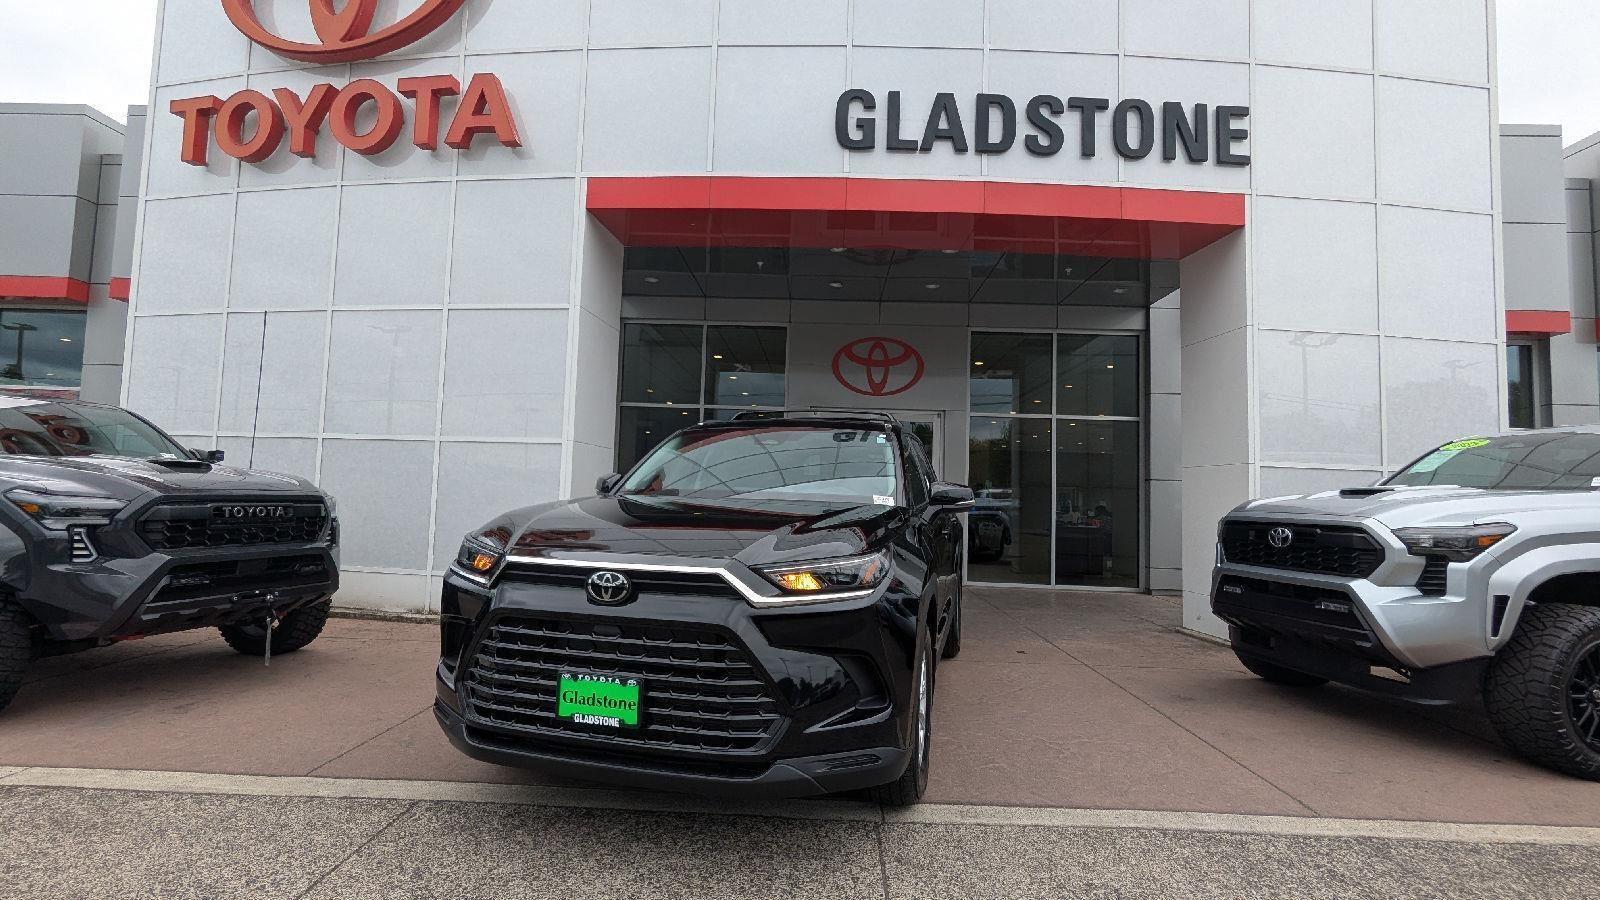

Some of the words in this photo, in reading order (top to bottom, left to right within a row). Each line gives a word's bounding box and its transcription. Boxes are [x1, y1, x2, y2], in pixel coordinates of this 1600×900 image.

[170, 73, 522, 166] TOYOTA
[835, 88, 1251, 166] GLADSTONE
[223, 506, 285, 517] TOYOTA
[577, 674, 620, 684] TOYOTA
[562, 690, 636, 710] Gladstone
[574, 713, 619, 727] GLADSTONE
